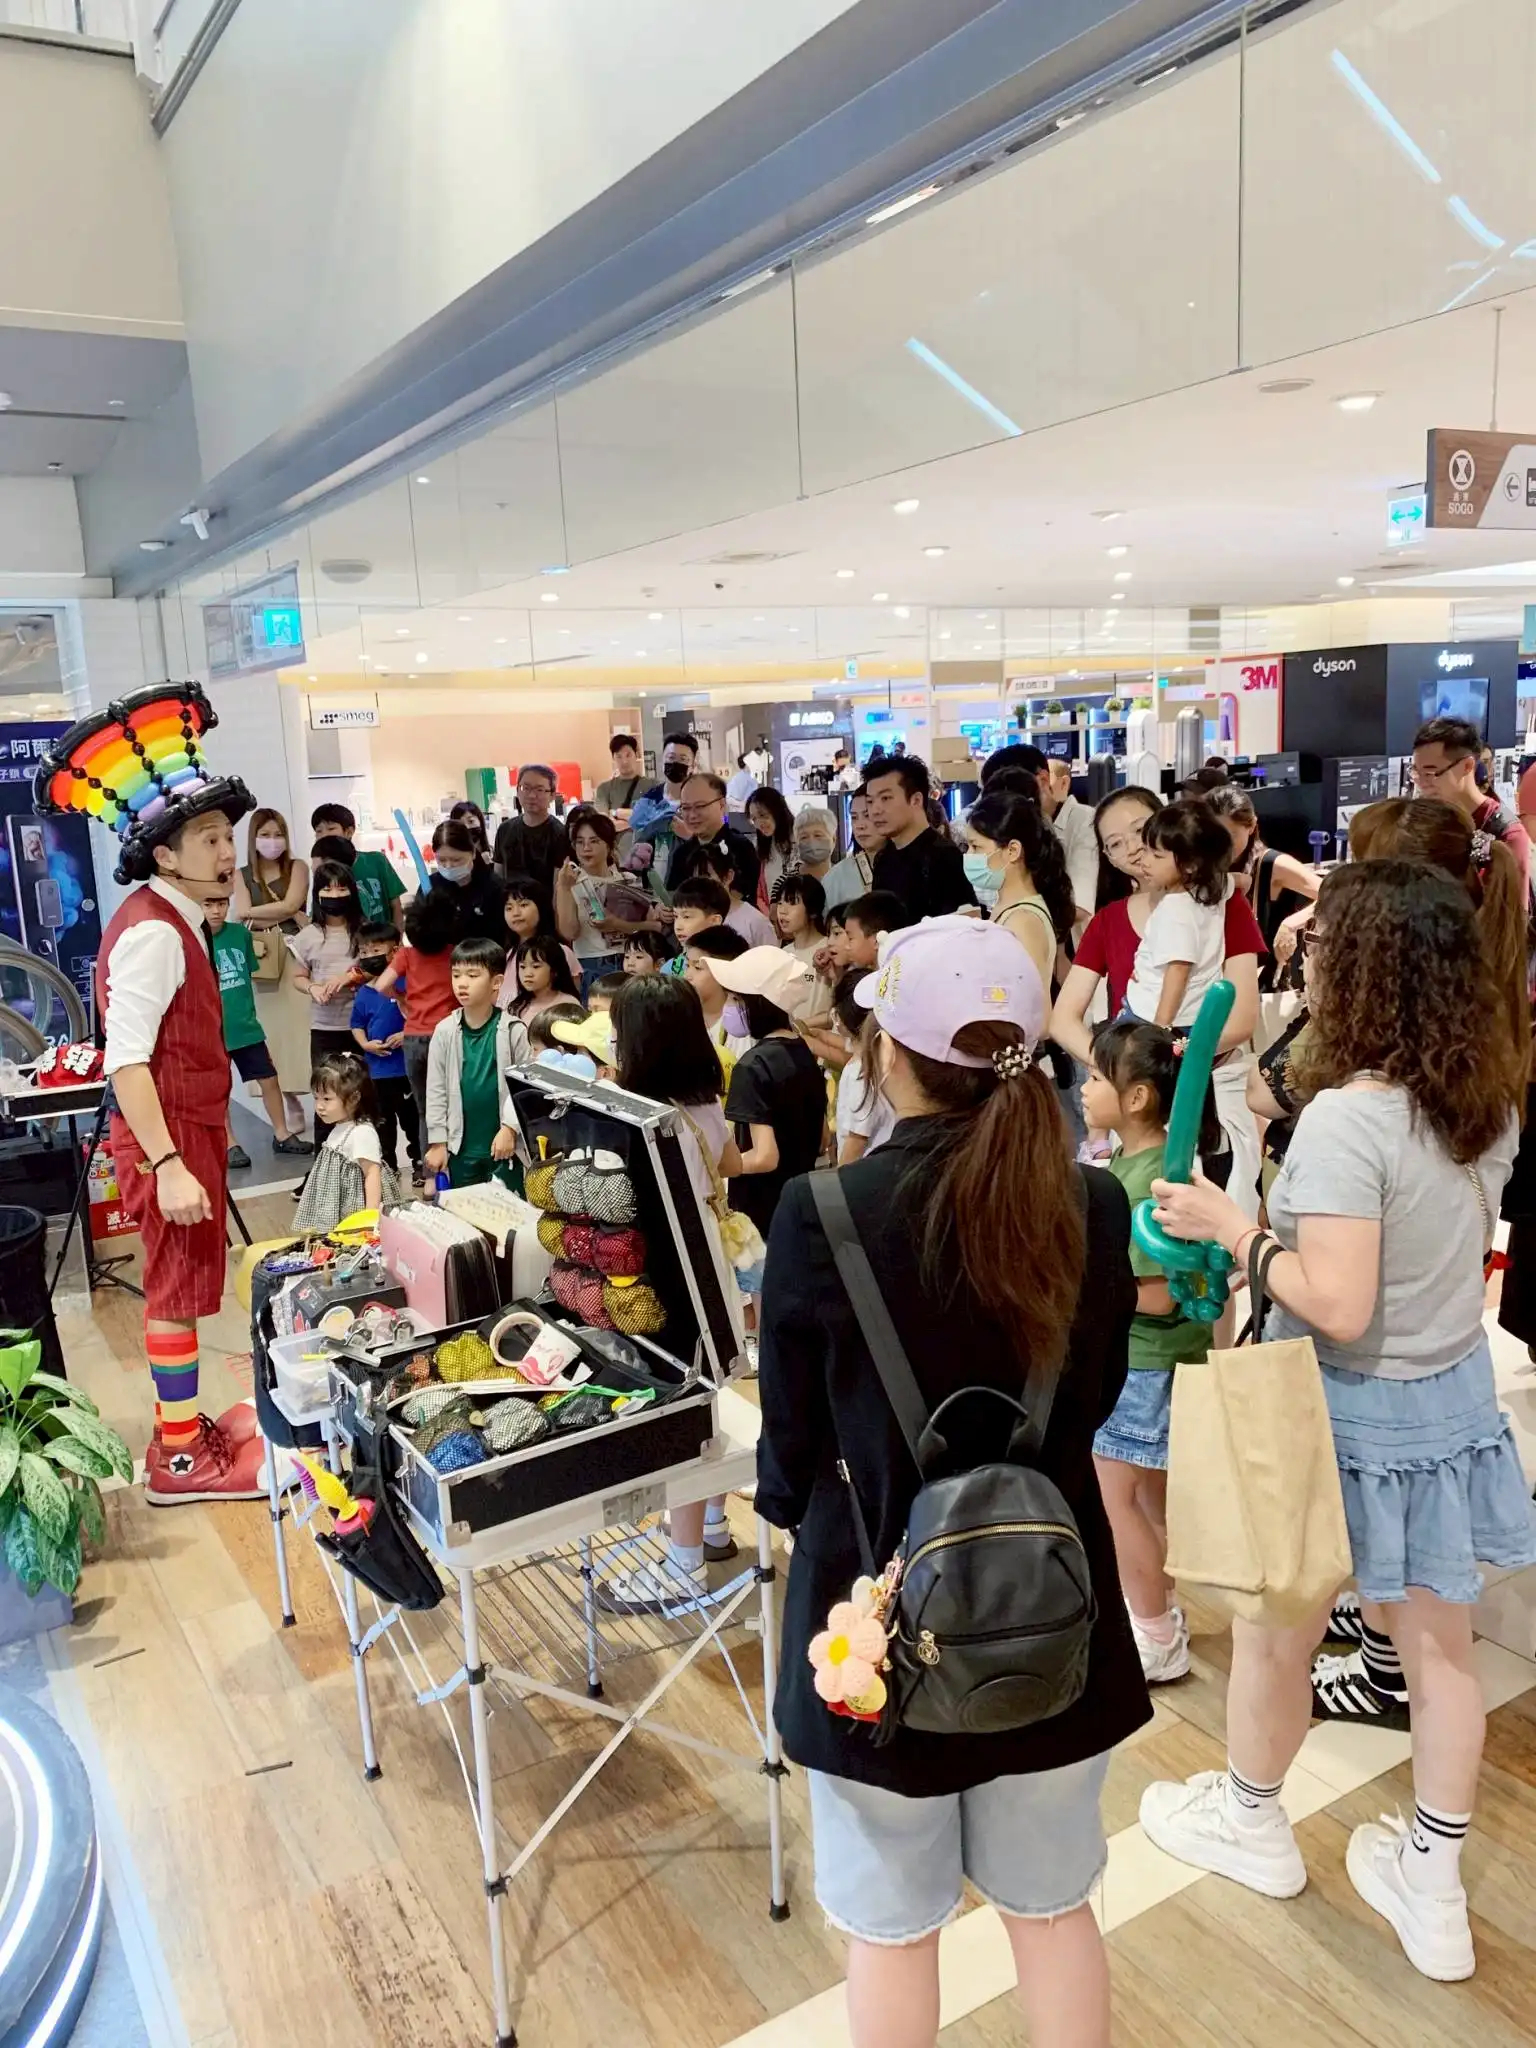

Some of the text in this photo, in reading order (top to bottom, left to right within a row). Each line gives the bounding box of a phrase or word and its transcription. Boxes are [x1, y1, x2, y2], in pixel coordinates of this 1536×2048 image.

[1448, 502, 1473, 514] SOGO
[1313, 657, 1356, 677] dyson
[1438, 650, 1474, 671] dyson
[1241, 665, 1277, 690] 3M
[340, 711, 374, 722] smeg
